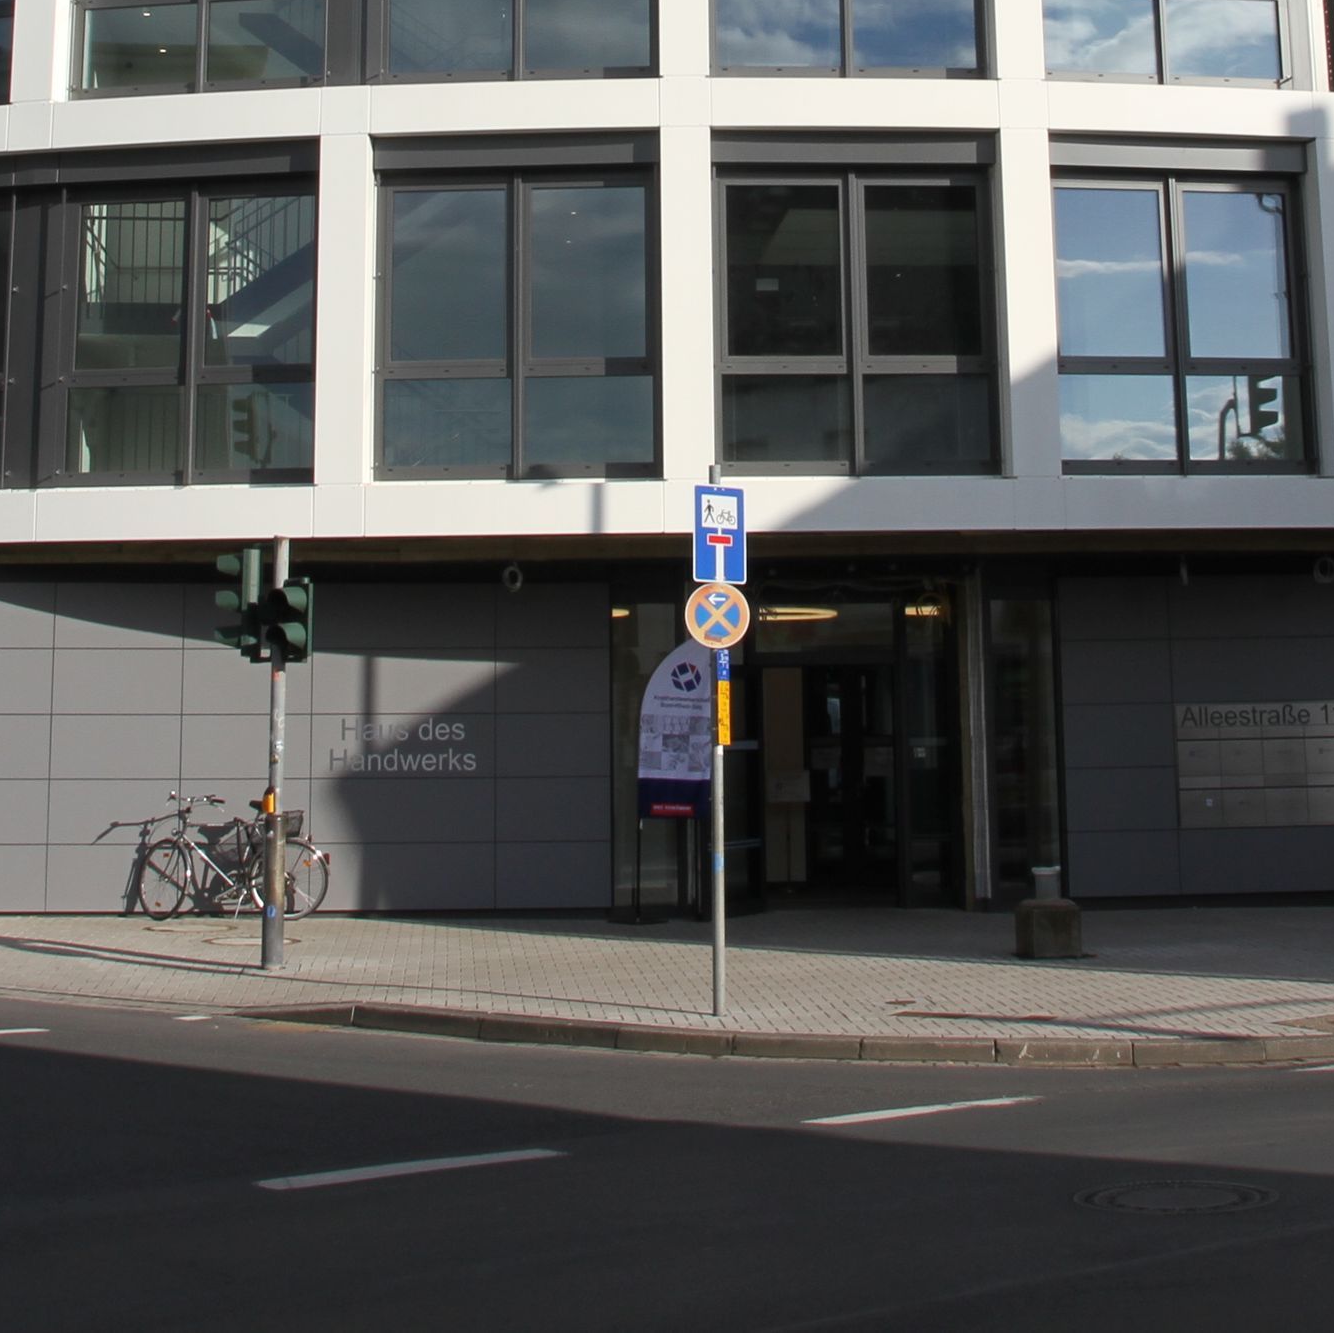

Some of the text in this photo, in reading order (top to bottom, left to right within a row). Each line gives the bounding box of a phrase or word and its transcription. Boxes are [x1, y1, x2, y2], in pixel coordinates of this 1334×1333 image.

[1181, 703, 1310, 727] Alleestraße
[341, 717, 465, 741] Haus des
[329, 748, 477, 771] Handwerks
